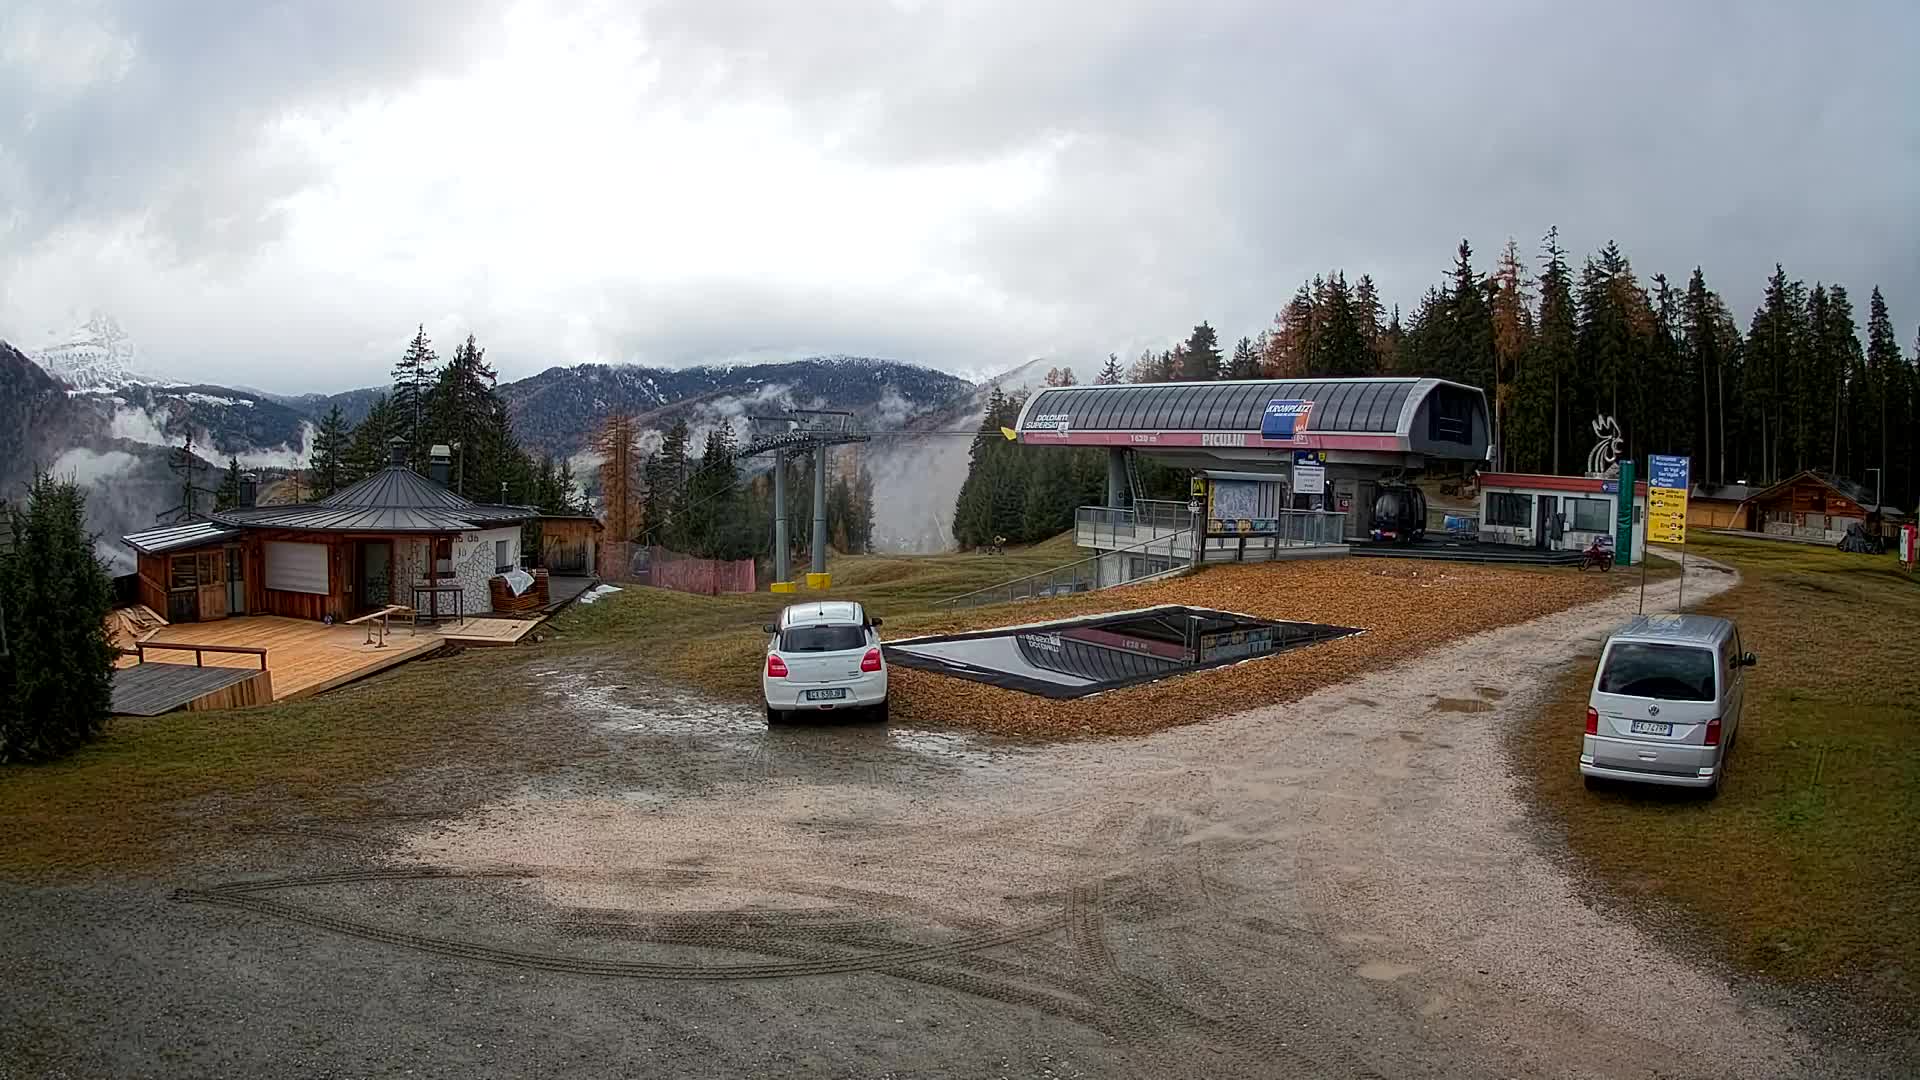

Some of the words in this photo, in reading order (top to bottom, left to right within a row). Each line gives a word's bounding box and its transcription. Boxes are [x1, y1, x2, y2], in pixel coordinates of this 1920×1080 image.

[1267, 404, 1310, 413] KRONPLATZ
[1026, 421, 1058, 429] SUPERSKI
[1202, 433, 1245, 447] PICULIN
